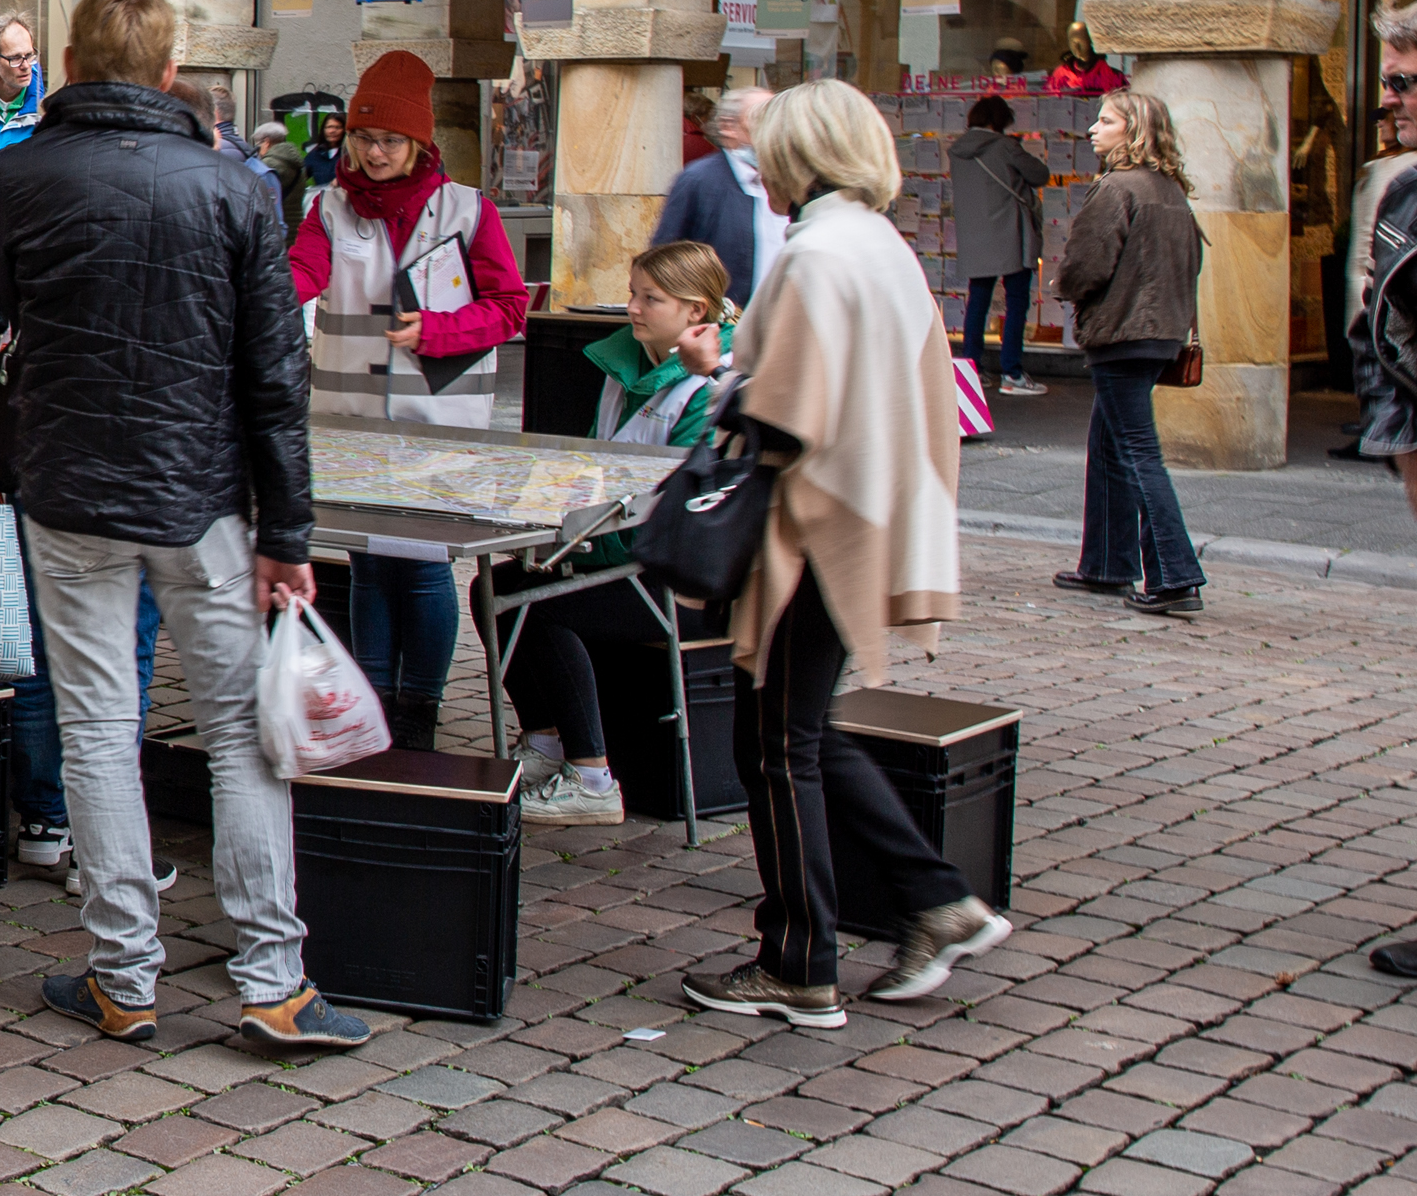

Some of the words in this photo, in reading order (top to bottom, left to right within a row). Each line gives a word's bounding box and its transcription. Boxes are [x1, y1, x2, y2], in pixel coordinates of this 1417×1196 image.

[722, 2, 757, 23] SERVIC
[902, 71, 963, 90] DEINE
[972, 75, 1028, 90] IDEEN
